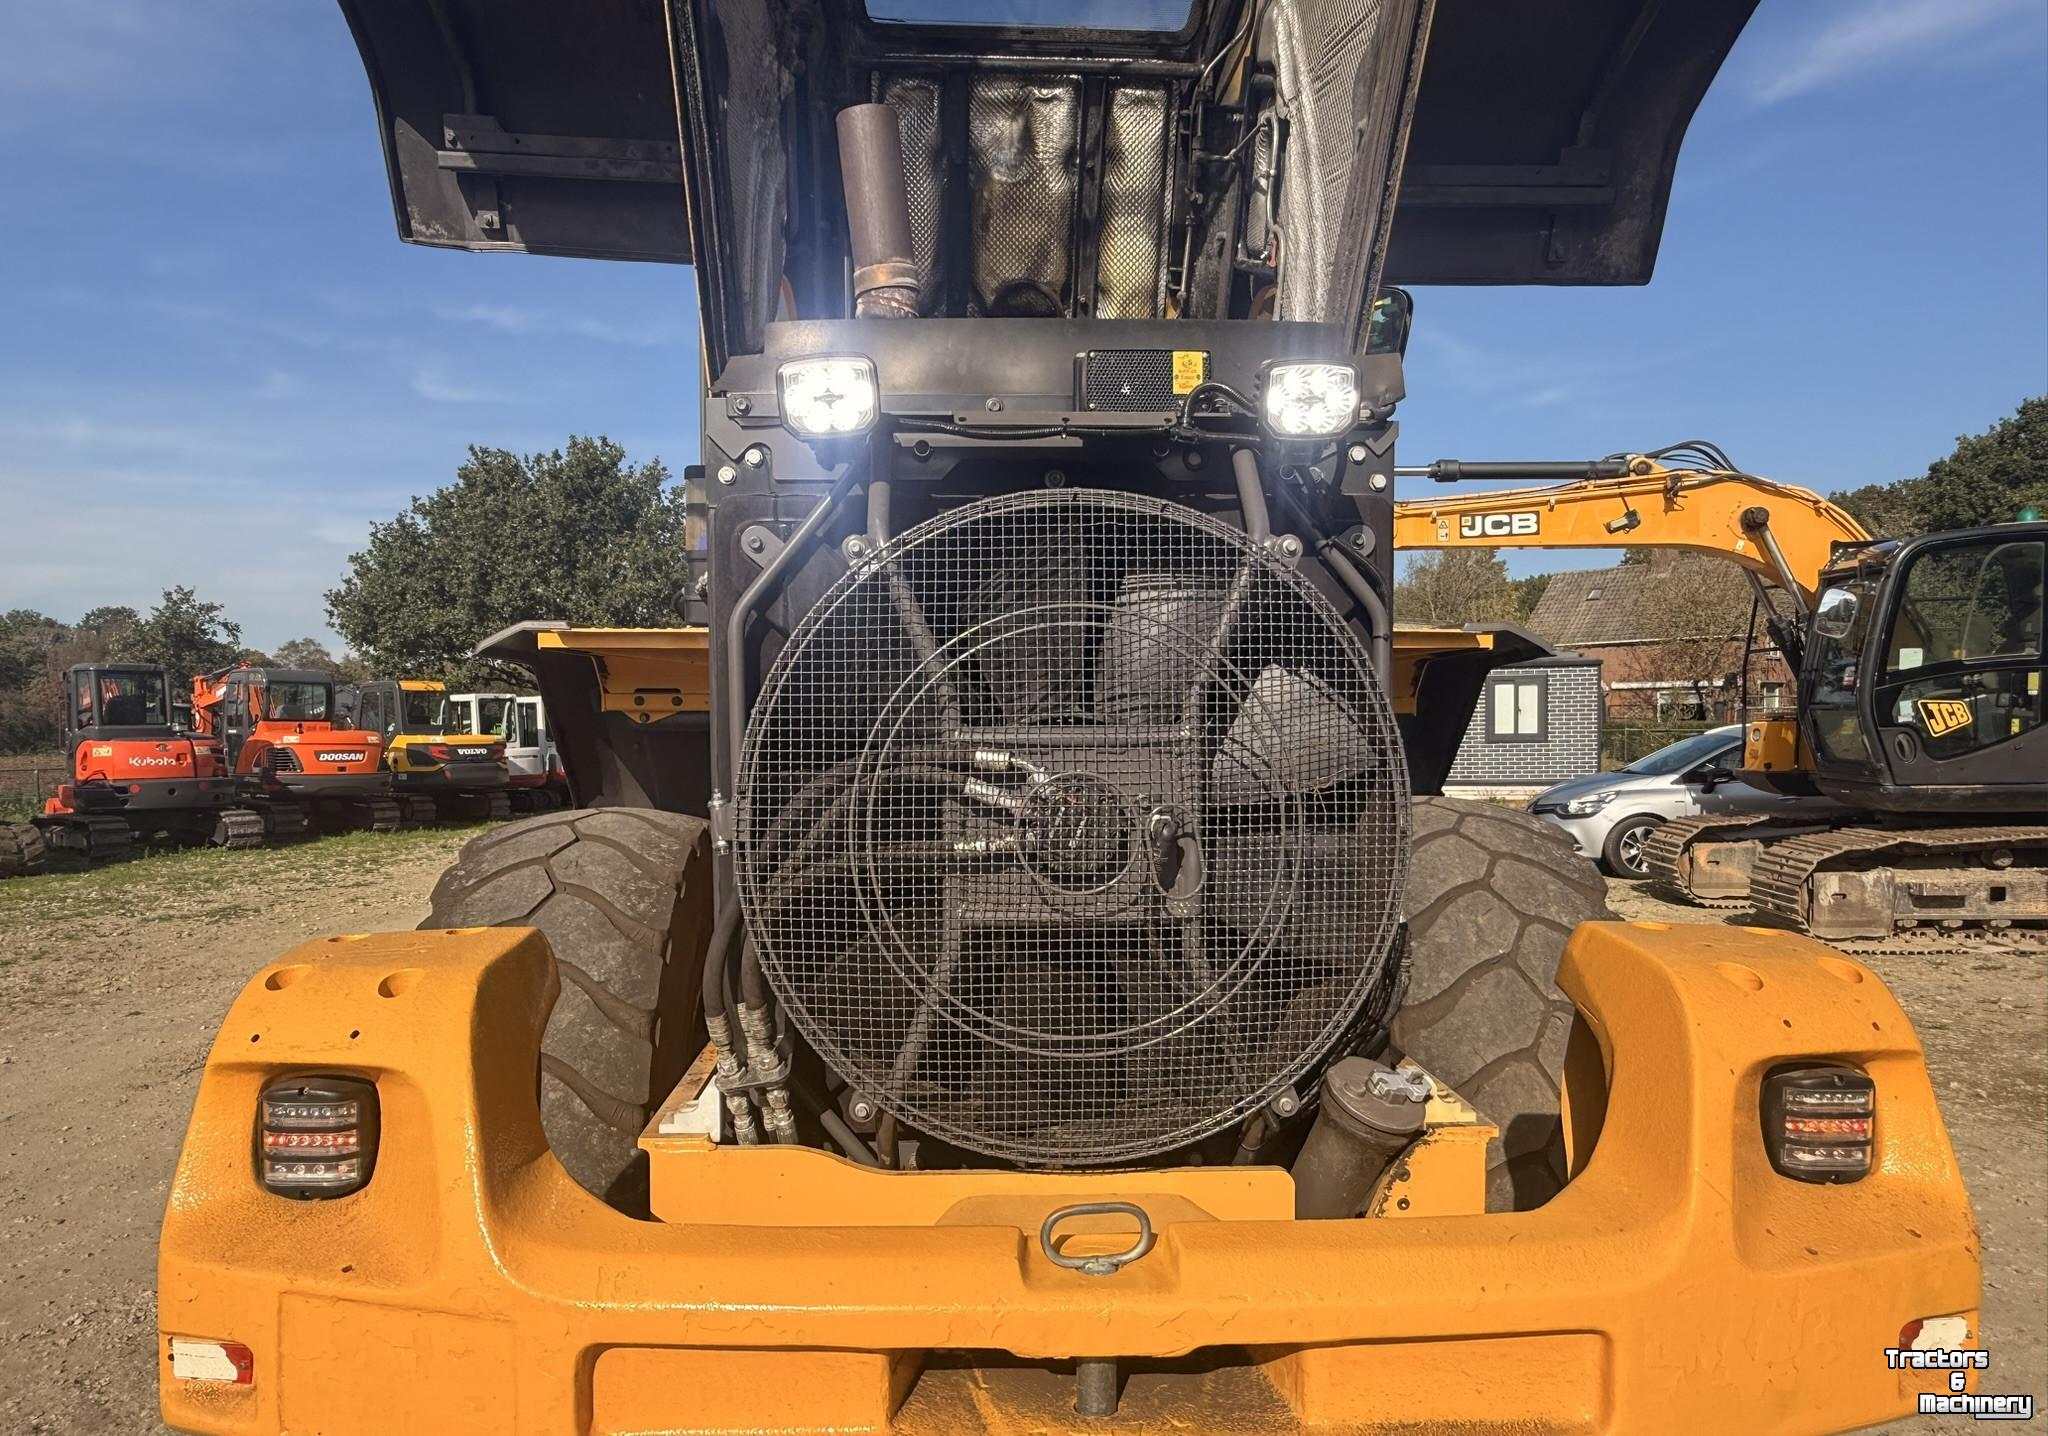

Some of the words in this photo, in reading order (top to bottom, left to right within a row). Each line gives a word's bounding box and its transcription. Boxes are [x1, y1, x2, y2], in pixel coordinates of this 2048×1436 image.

[1461, 513, 1538, 537] JCB
[1926, 703, 1969, 733] JCB
[318, 752, 365, 762] DOOSAN
[456, 747, 488, 756] VOLVO
[128, 756, 177, 767] Kubota
